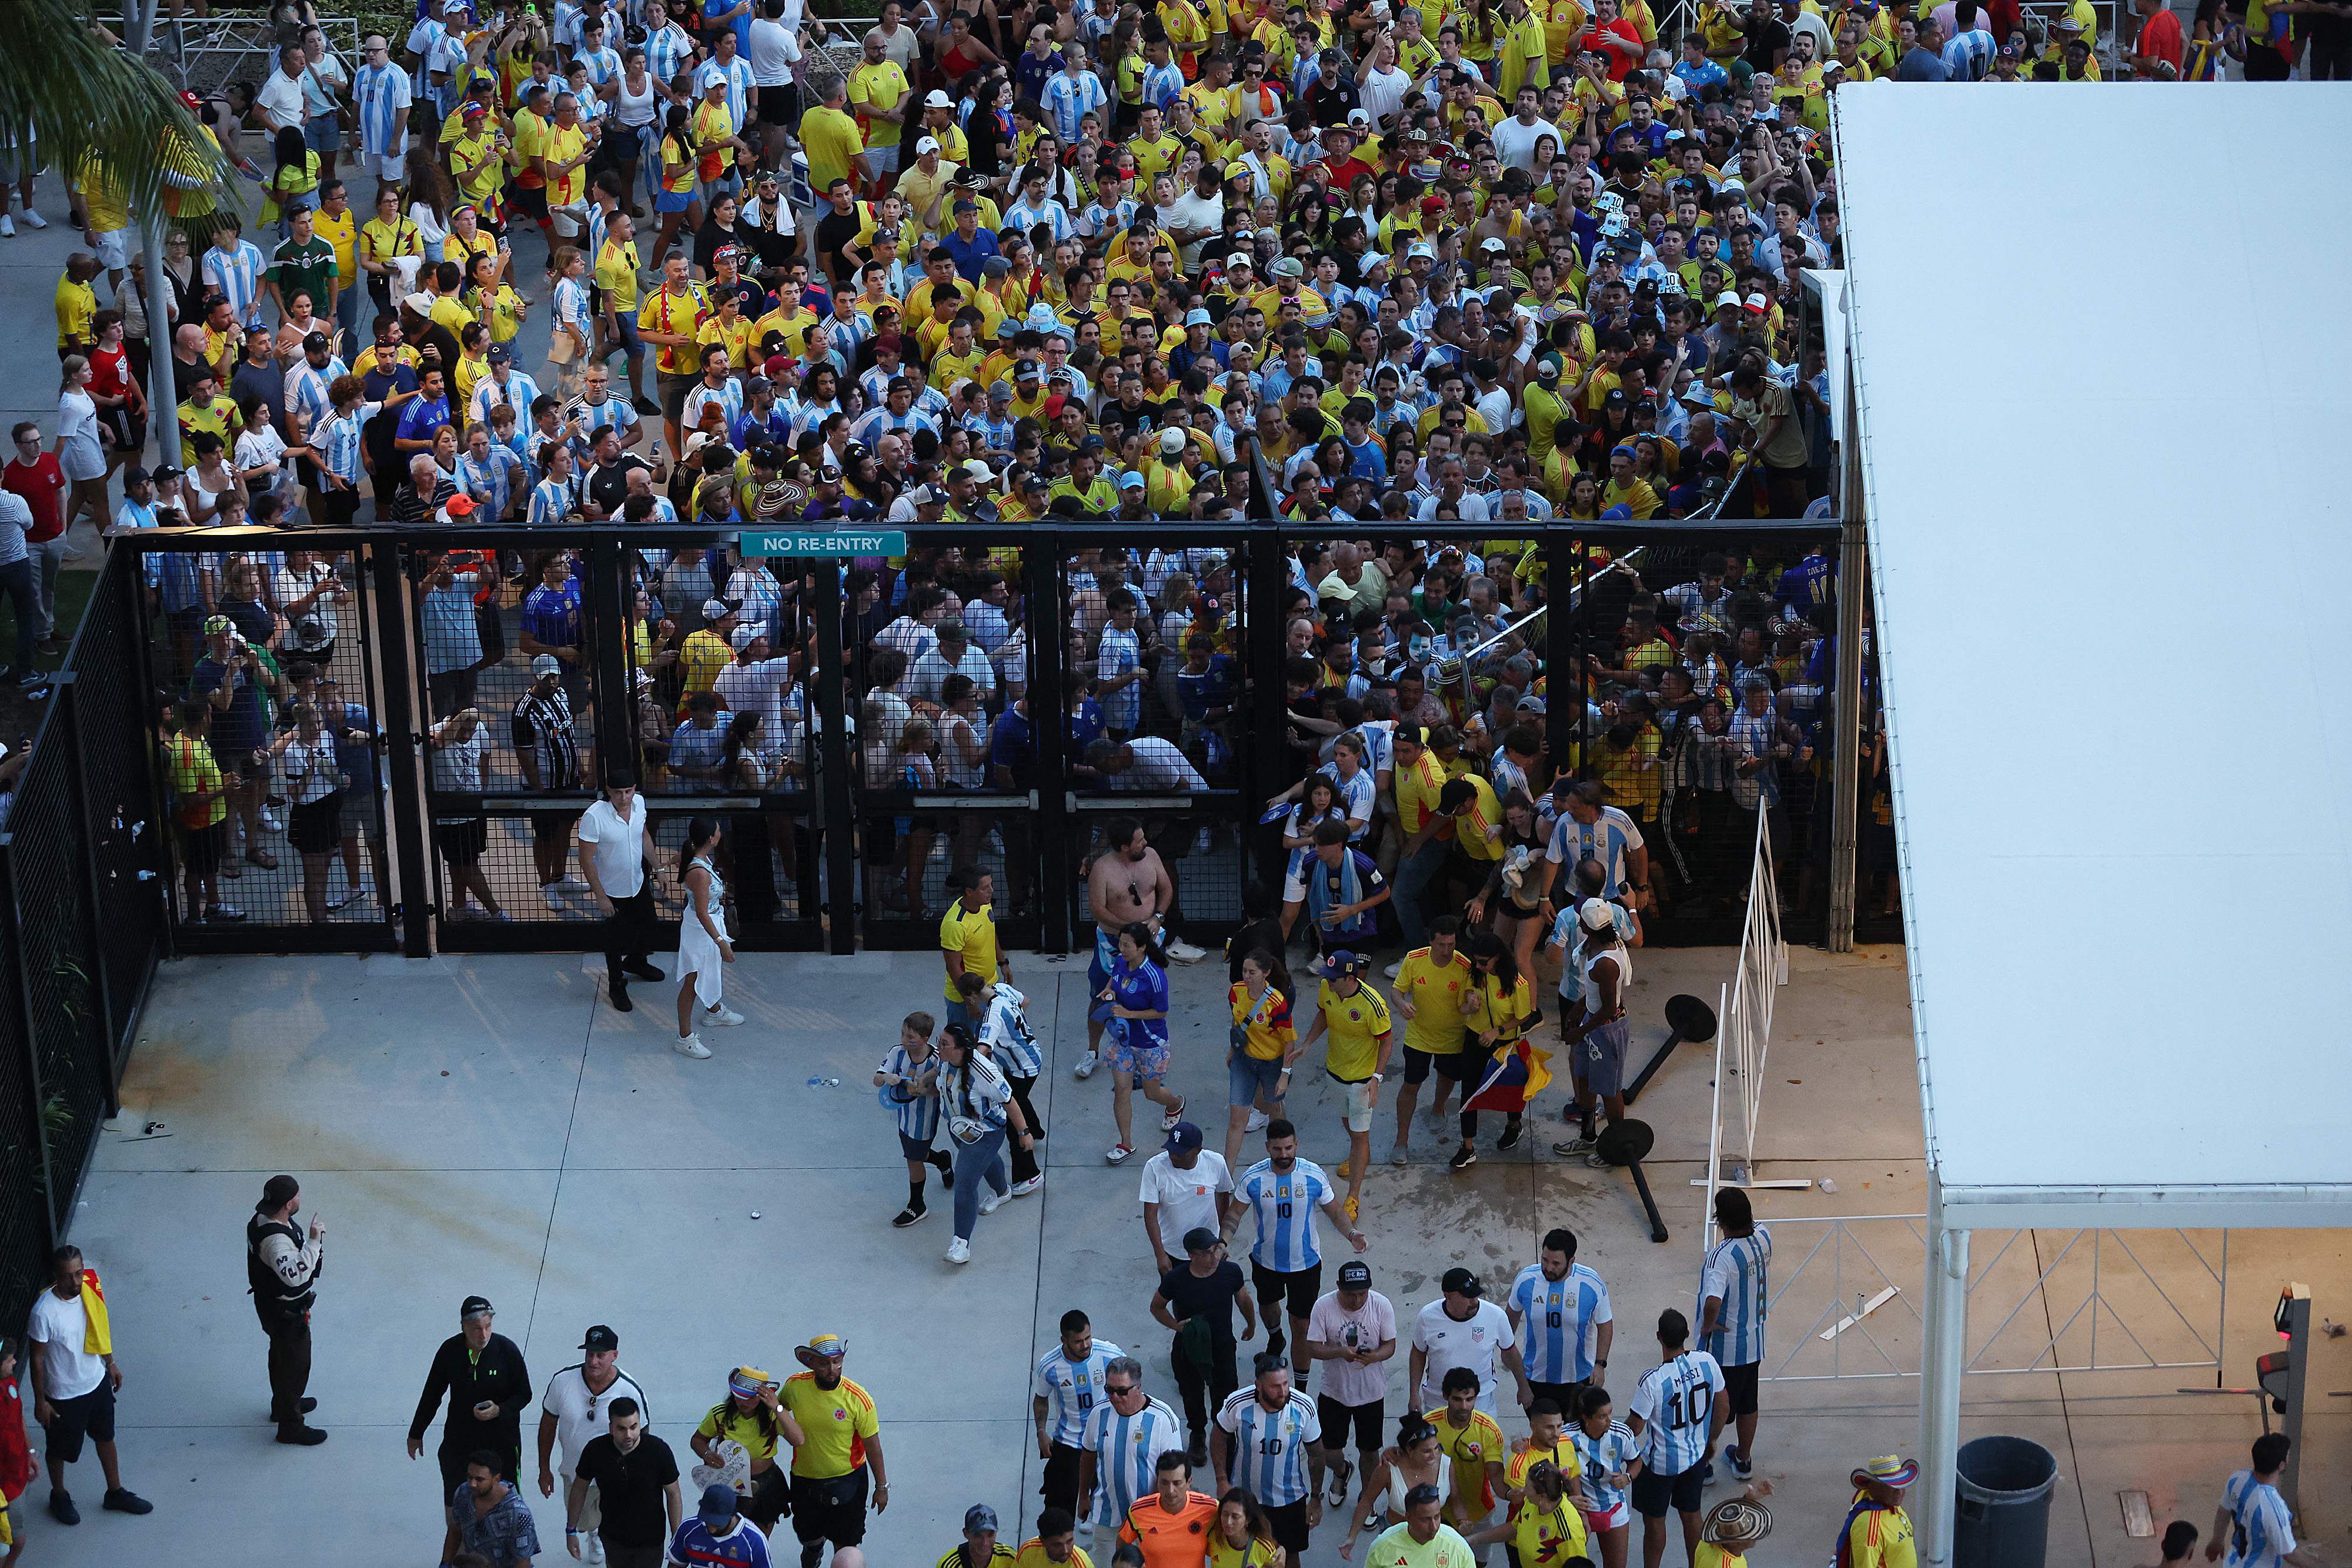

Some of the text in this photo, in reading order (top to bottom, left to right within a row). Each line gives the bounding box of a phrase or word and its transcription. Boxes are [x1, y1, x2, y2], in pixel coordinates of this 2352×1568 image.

[1969, 42, 1984, 51] MESSI
[366, 89, 375, 101] 10
[1021, 151, 1026, 165] 9
[1612, 196, 1622, 207] 10
[1620, 219, 1628, 230] 10
[1665, 275, 1675, 286] 10
[500, 304, 506, 314] 9
[1706, 480, 1713, 489] B
[764, 537, 883, 550] NO RE-ENTRY
[1807, 563, 1828, 576] MESS
[1336, 613, 1344, 622] A
[1345, 962, 1353, 972] 10
[1277, 1202, 1292, 1219] 10
[1546, 1311, 1562, 1329] 10
[1674, 1367, 1700, 1388] MESSI
[1078, 1392, 1093, 1410] 10
[1667, 1382, 1711, 1431] 10
[1259, 1438, 1282, 1456] 10
[1585, 1460, 1605, 1479] 10
